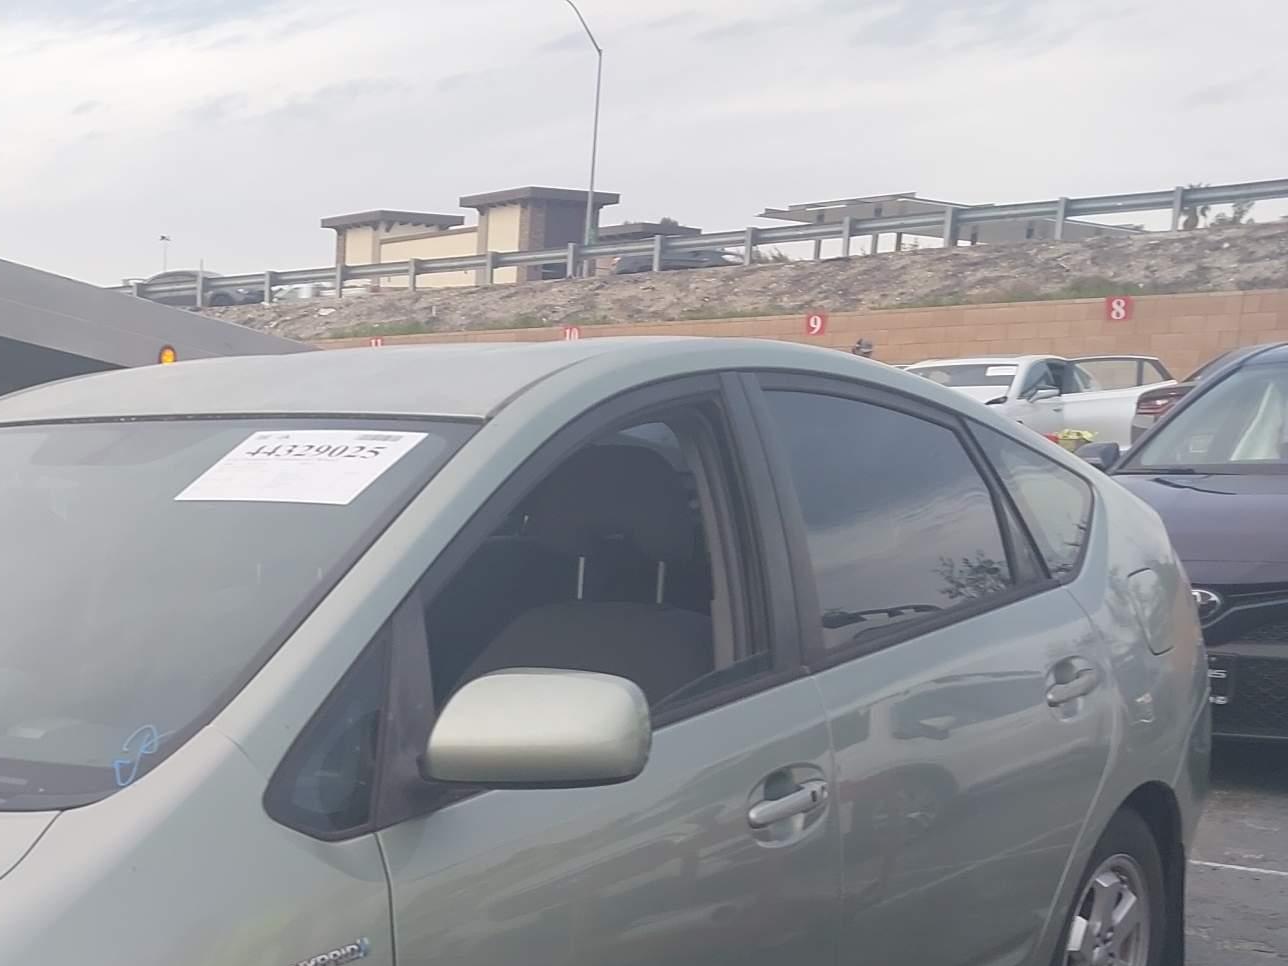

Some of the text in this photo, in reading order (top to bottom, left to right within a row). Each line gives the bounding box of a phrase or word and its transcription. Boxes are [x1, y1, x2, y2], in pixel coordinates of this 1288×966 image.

[1110, 298, 1126, 320] 8
[808, 315, 822, 335] 9
[245, 444, 388, 459] 44329025
